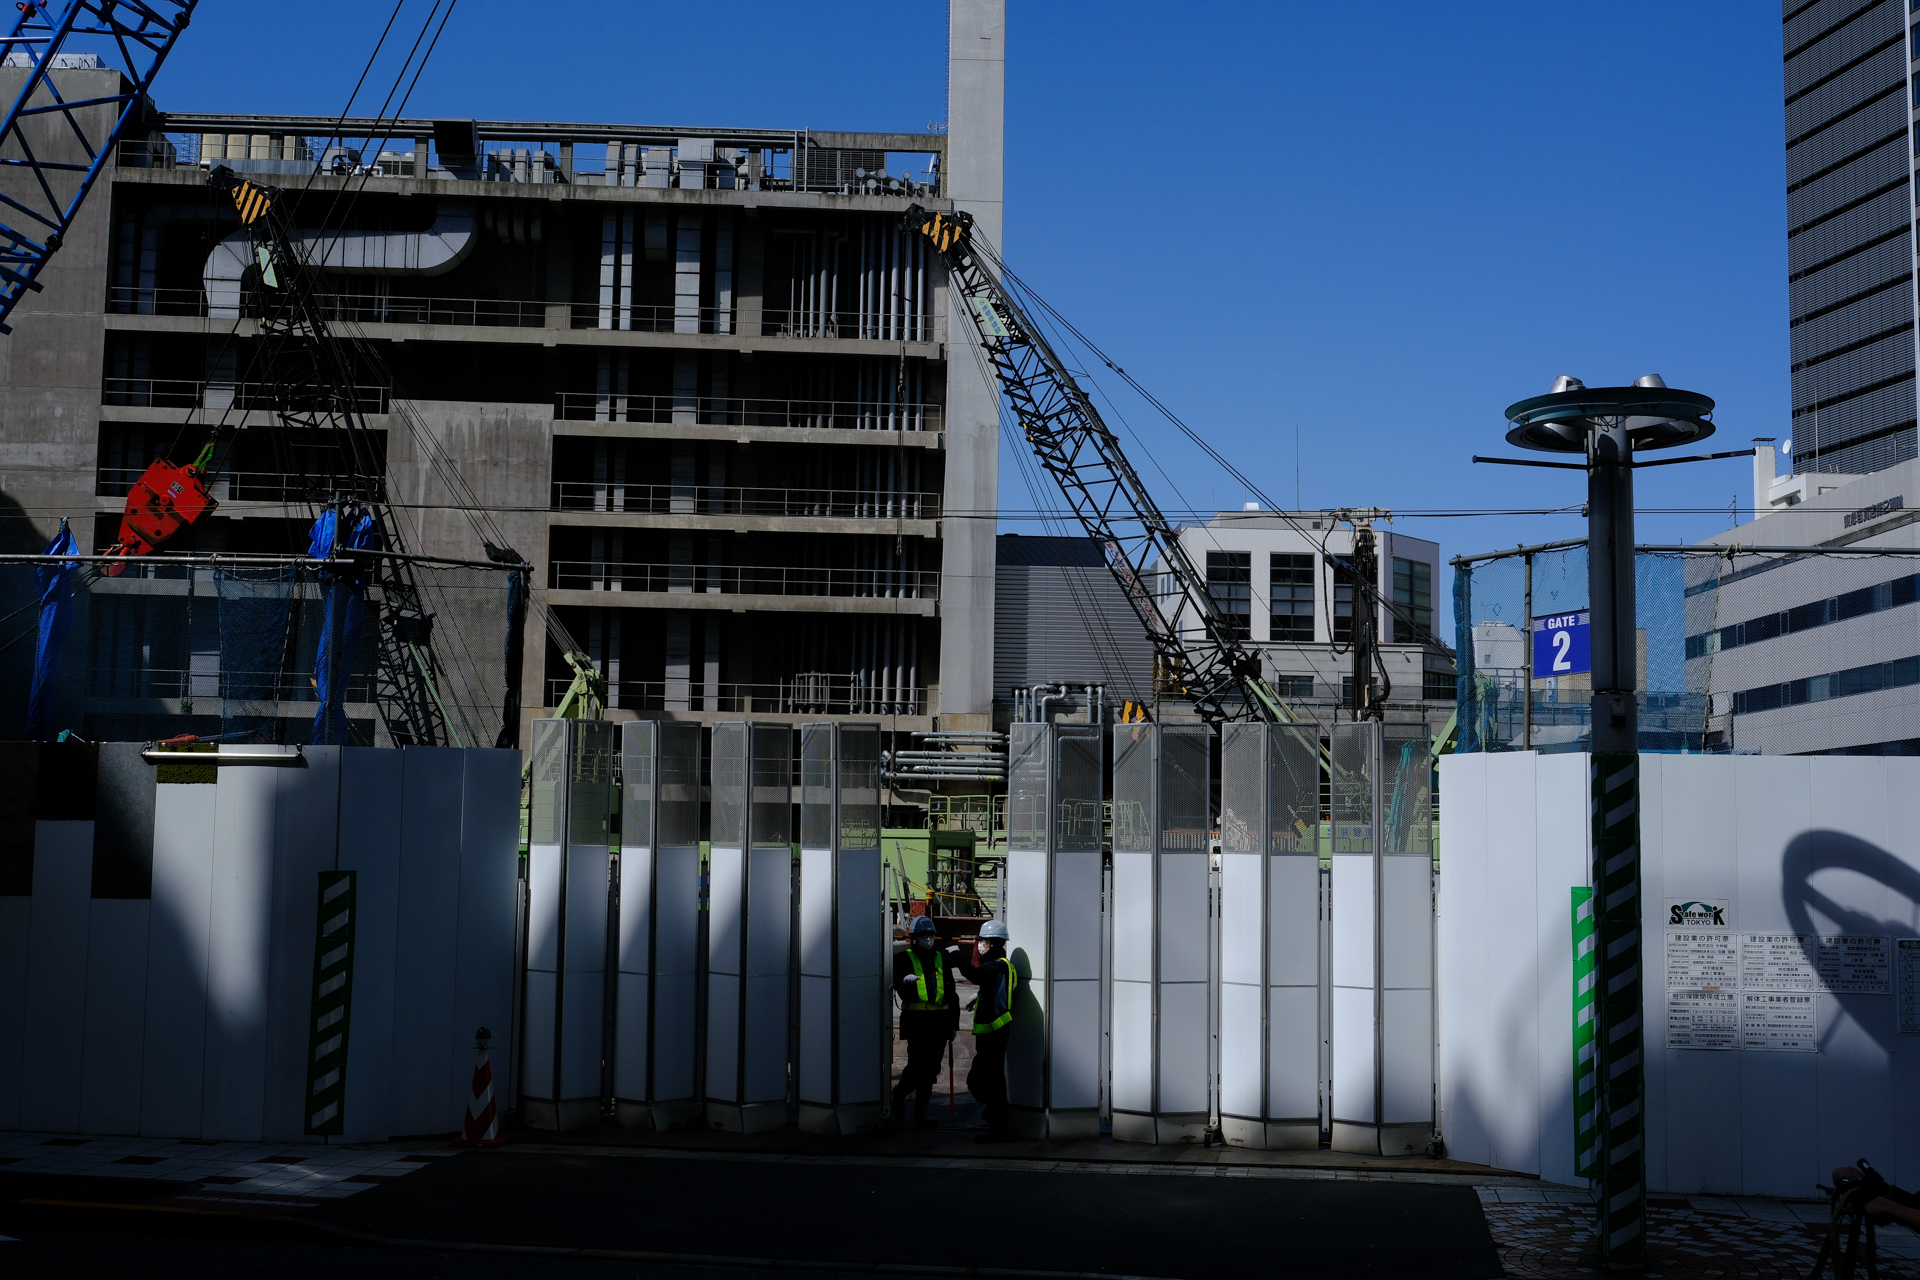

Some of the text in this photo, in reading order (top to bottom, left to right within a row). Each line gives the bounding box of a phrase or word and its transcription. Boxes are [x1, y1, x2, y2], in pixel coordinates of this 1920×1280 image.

[1547, 615, 1576, 630] GATE
[1552, 630, 1571, 672] 2
[1675, 934, 1729, 942] 建設業の許可票
[1750, 935, 1805, 943] 建設業の許可票
[1826, 937, 1881, 945] 建設業の許可票
[1672, 993, 1734, 1001] 労災保険関係成立票
[1746, 995, 1811, 1003] 解体工事業者登録票
